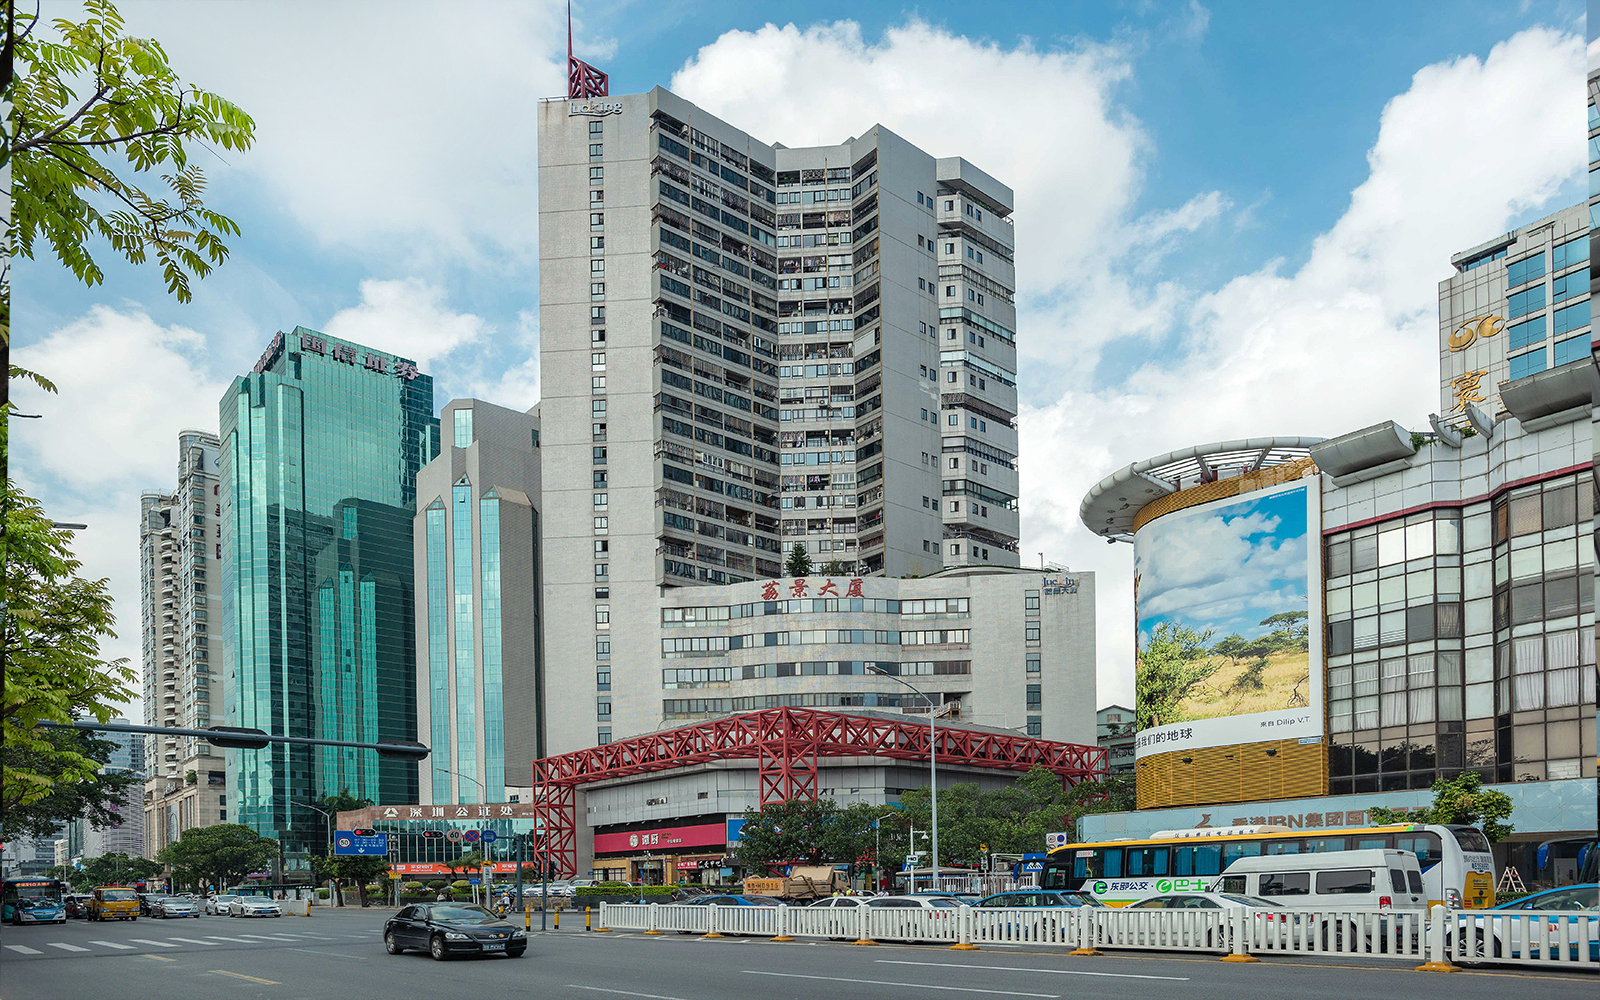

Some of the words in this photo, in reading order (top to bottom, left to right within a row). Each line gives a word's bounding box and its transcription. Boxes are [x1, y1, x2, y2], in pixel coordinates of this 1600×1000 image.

[301, 332, 420, 380] 国信证券
[761, 578, 865, 601] 荔景大厦
[1276, 718, 1296, 726] Dilip
[409, 806, 513, 818] 深圳公证处
[450, 831, 460, 839] 60
[1110, 881, 1149, 891] 东部公交
